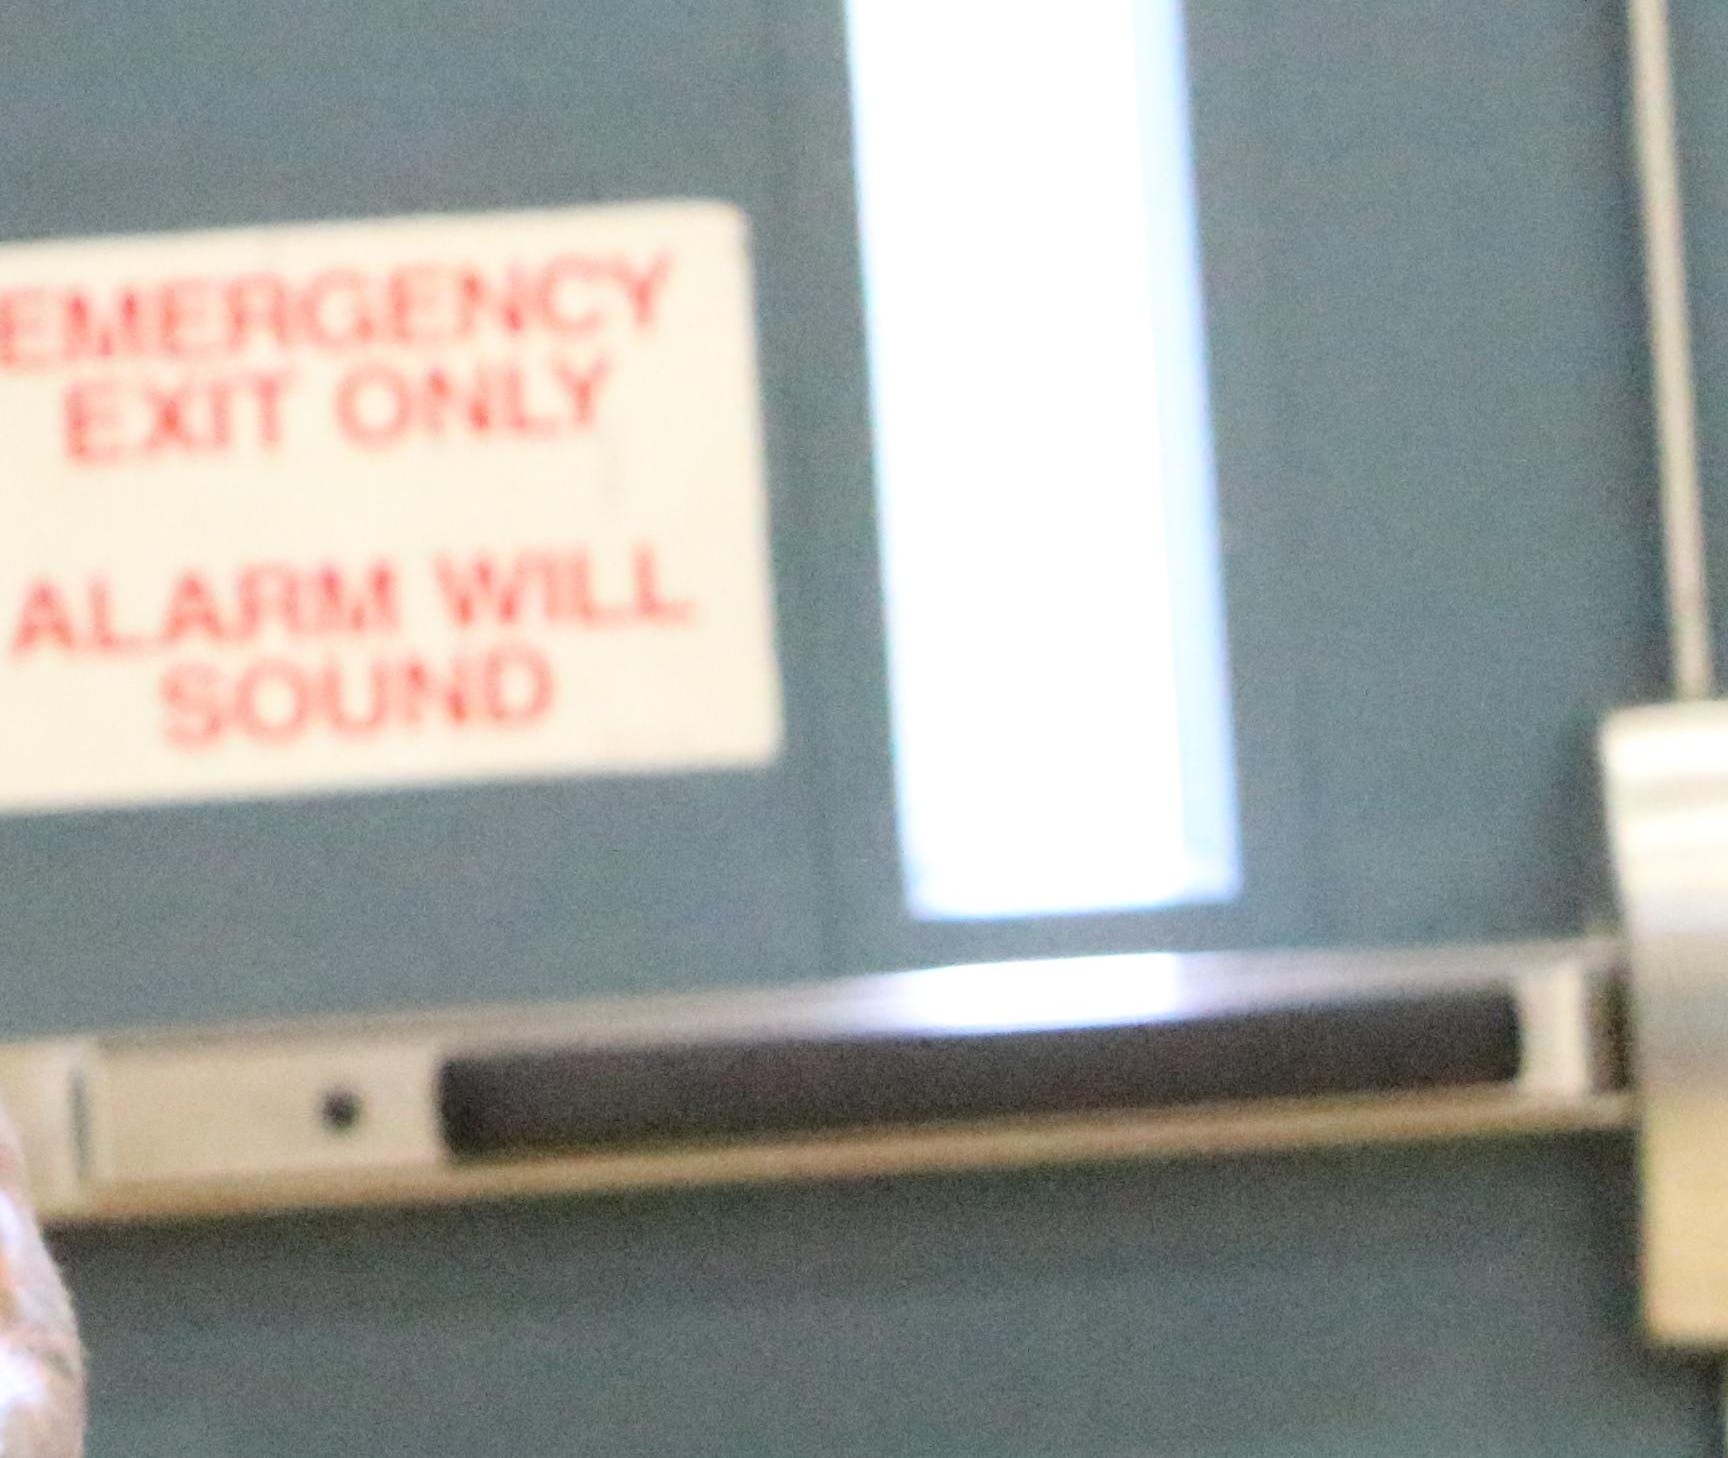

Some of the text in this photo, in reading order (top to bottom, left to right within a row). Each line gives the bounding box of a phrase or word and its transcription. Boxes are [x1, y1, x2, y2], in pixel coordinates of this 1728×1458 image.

[62, 357, 610, 466] EXIT ONLY
[11, 544, 692, 659] ALARM WILL
[160, 644, 556, 748] SOUND
